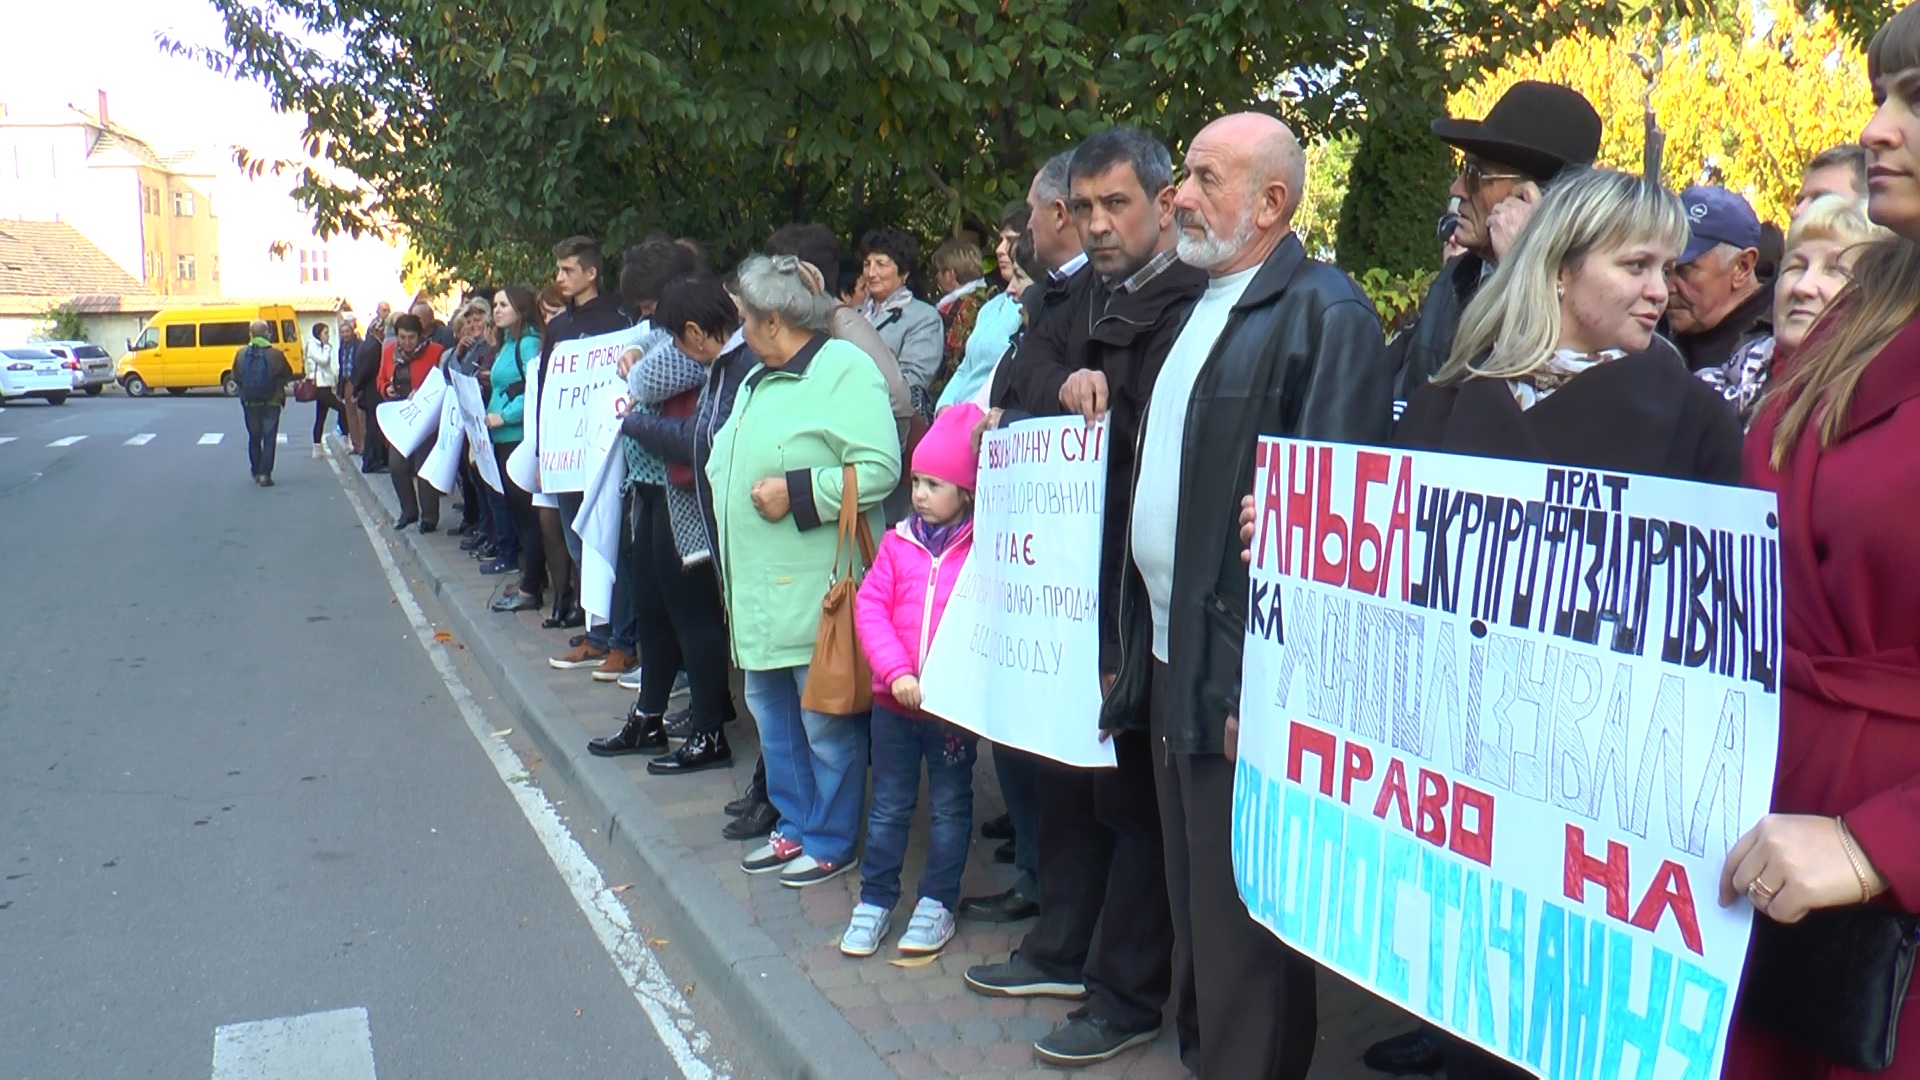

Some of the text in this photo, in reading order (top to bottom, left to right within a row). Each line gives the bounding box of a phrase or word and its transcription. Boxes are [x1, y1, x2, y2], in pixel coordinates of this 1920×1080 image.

[552, 354, 579, 375] НЕ
[1545, 467, 1629, 512] ПРАТ
[1286, 719, 1704, 957] ПРАВО НА
[1232, 755, 1729, 1080] ВОДОПОСТАЧАННЯ
